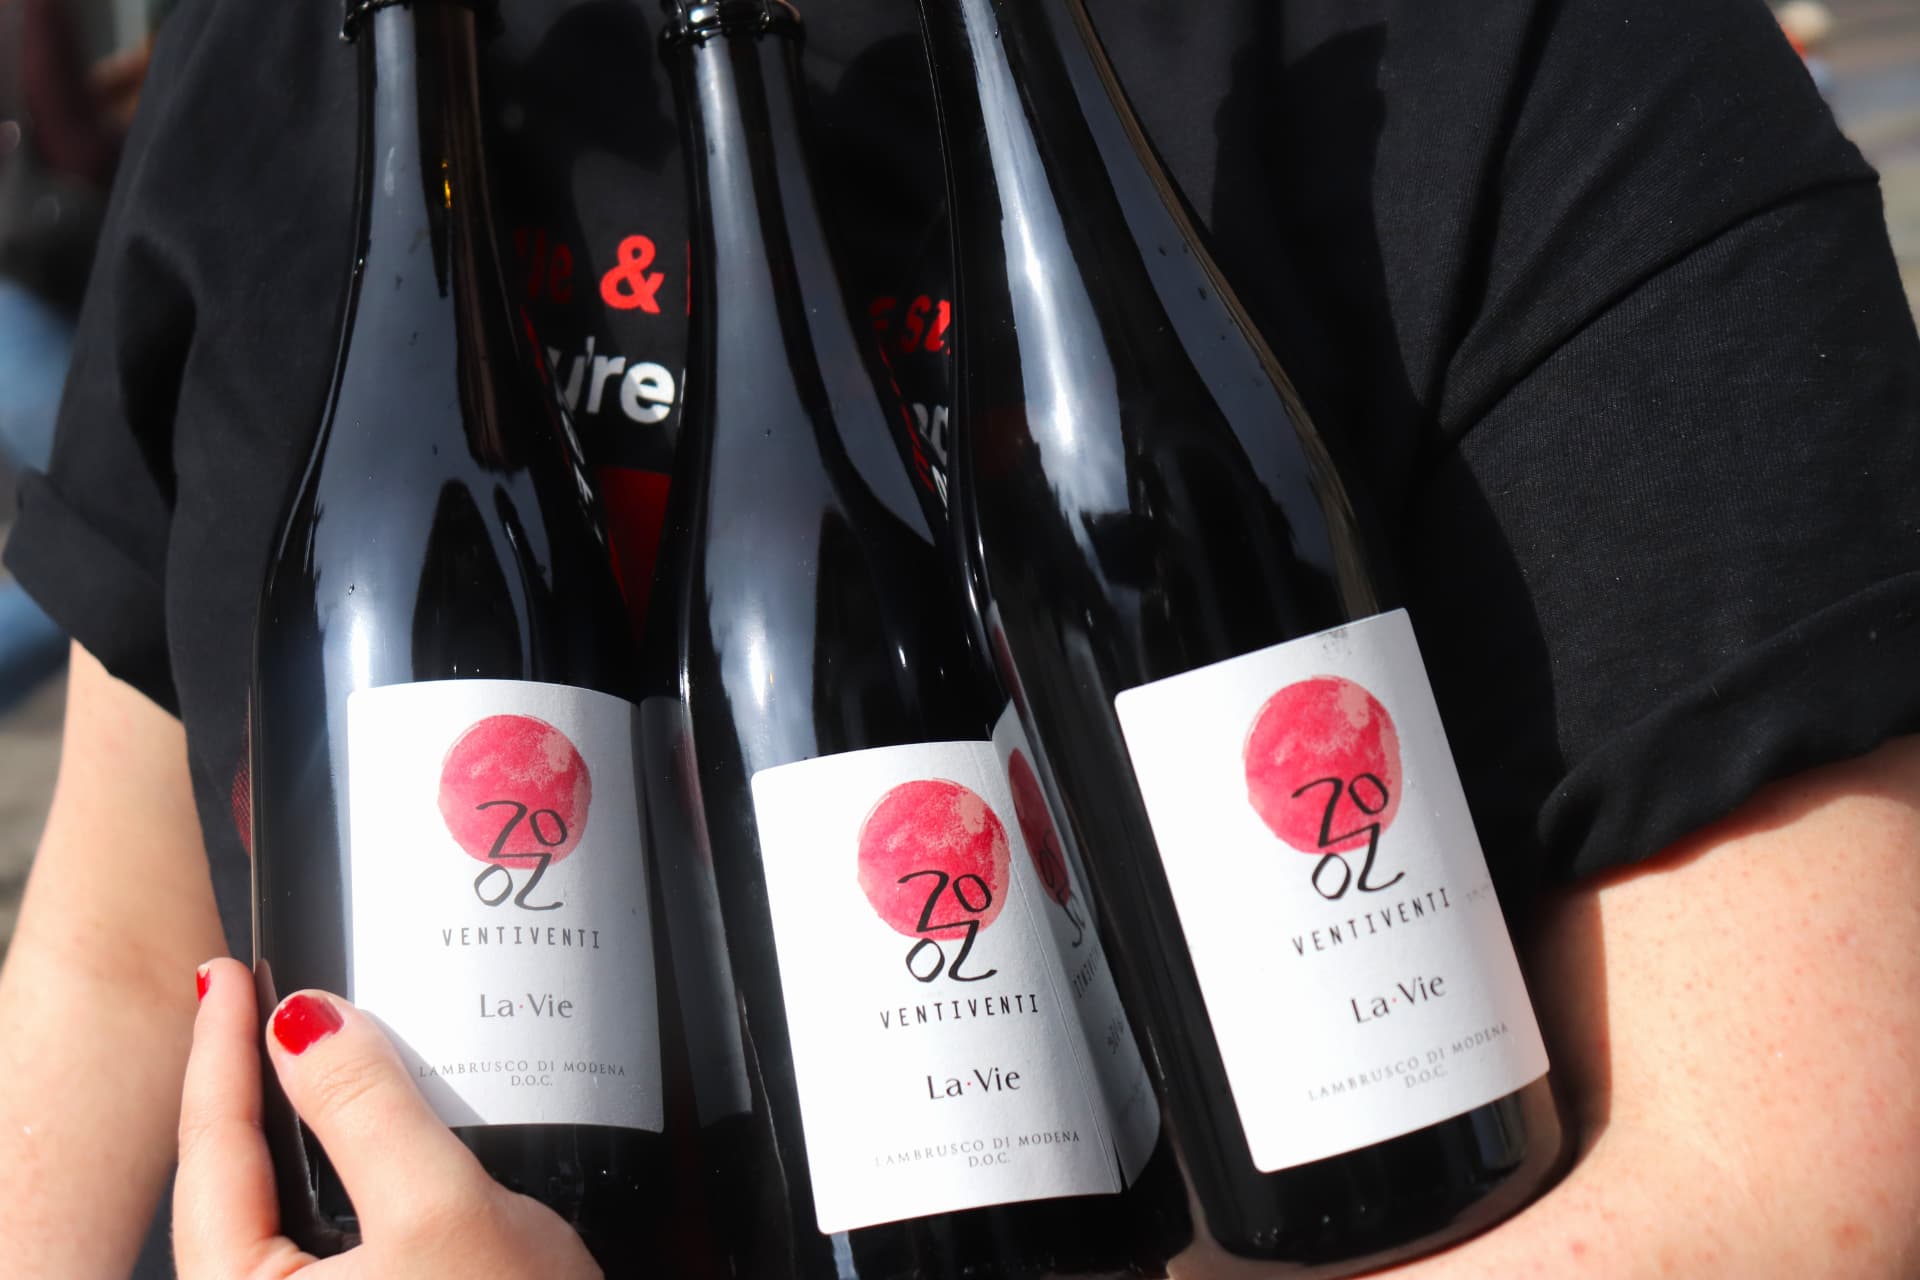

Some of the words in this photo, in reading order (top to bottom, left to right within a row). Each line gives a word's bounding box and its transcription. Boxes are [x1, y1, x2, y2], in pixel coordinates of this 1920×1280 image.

[600, 234, 665, 314] &
[442, 925, 601, 950] VENTIVENTI
[1292, 888, 1451, 957] VENTIVENTI
[880, 993, 1040, 1030] VENTIVENTI
[419, 1060, 529, 1078] LAMBRUSCO
[537, 1060, 554, 1073] DI
[563, 1061, 626, 1077] MODENA
[1307, 1055, 1421, 1102] LAMBRUSCO
[1426, 1047, 1446, 1065] DI
[1451, 1022, 1509, 1055] MODENA
[1404, 1064, 1448, 1089] D.O.C.
[511, 1074, 553, 1087] D.O.C.
[875, 1139, 985, 1168] LAMBRUSCO
[993, 1135, 1011, 1150] DI
[1018, 1130, 1081, 1148] MODENA
[968, 1152, 1011, 1168] D.O.C.
